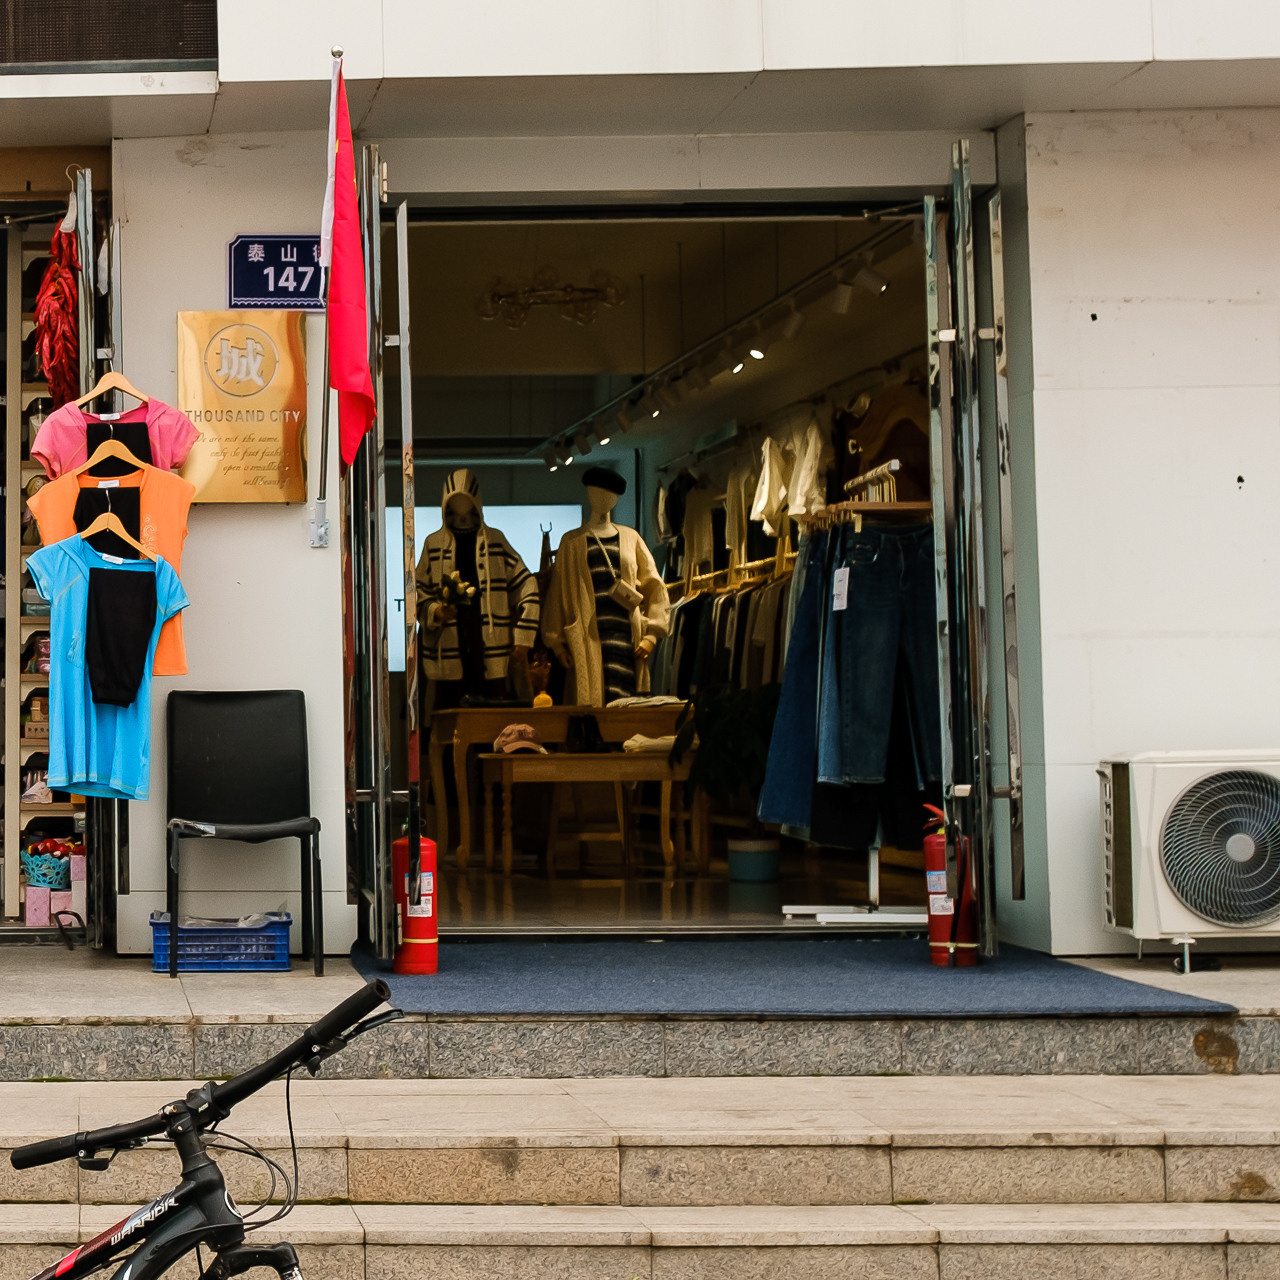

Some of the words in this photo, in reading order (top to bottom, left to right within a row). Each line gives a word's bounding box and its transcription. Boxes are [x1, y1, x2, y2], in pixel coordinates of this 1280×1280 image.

[263, 266, 315, 292] 147
[216, 337, 265, 387] 城
[185, 409, 265, 423] THOUSAND
[241, 432, 256, 443] the
[110, 1196, 179, 1246] WARRIOR
